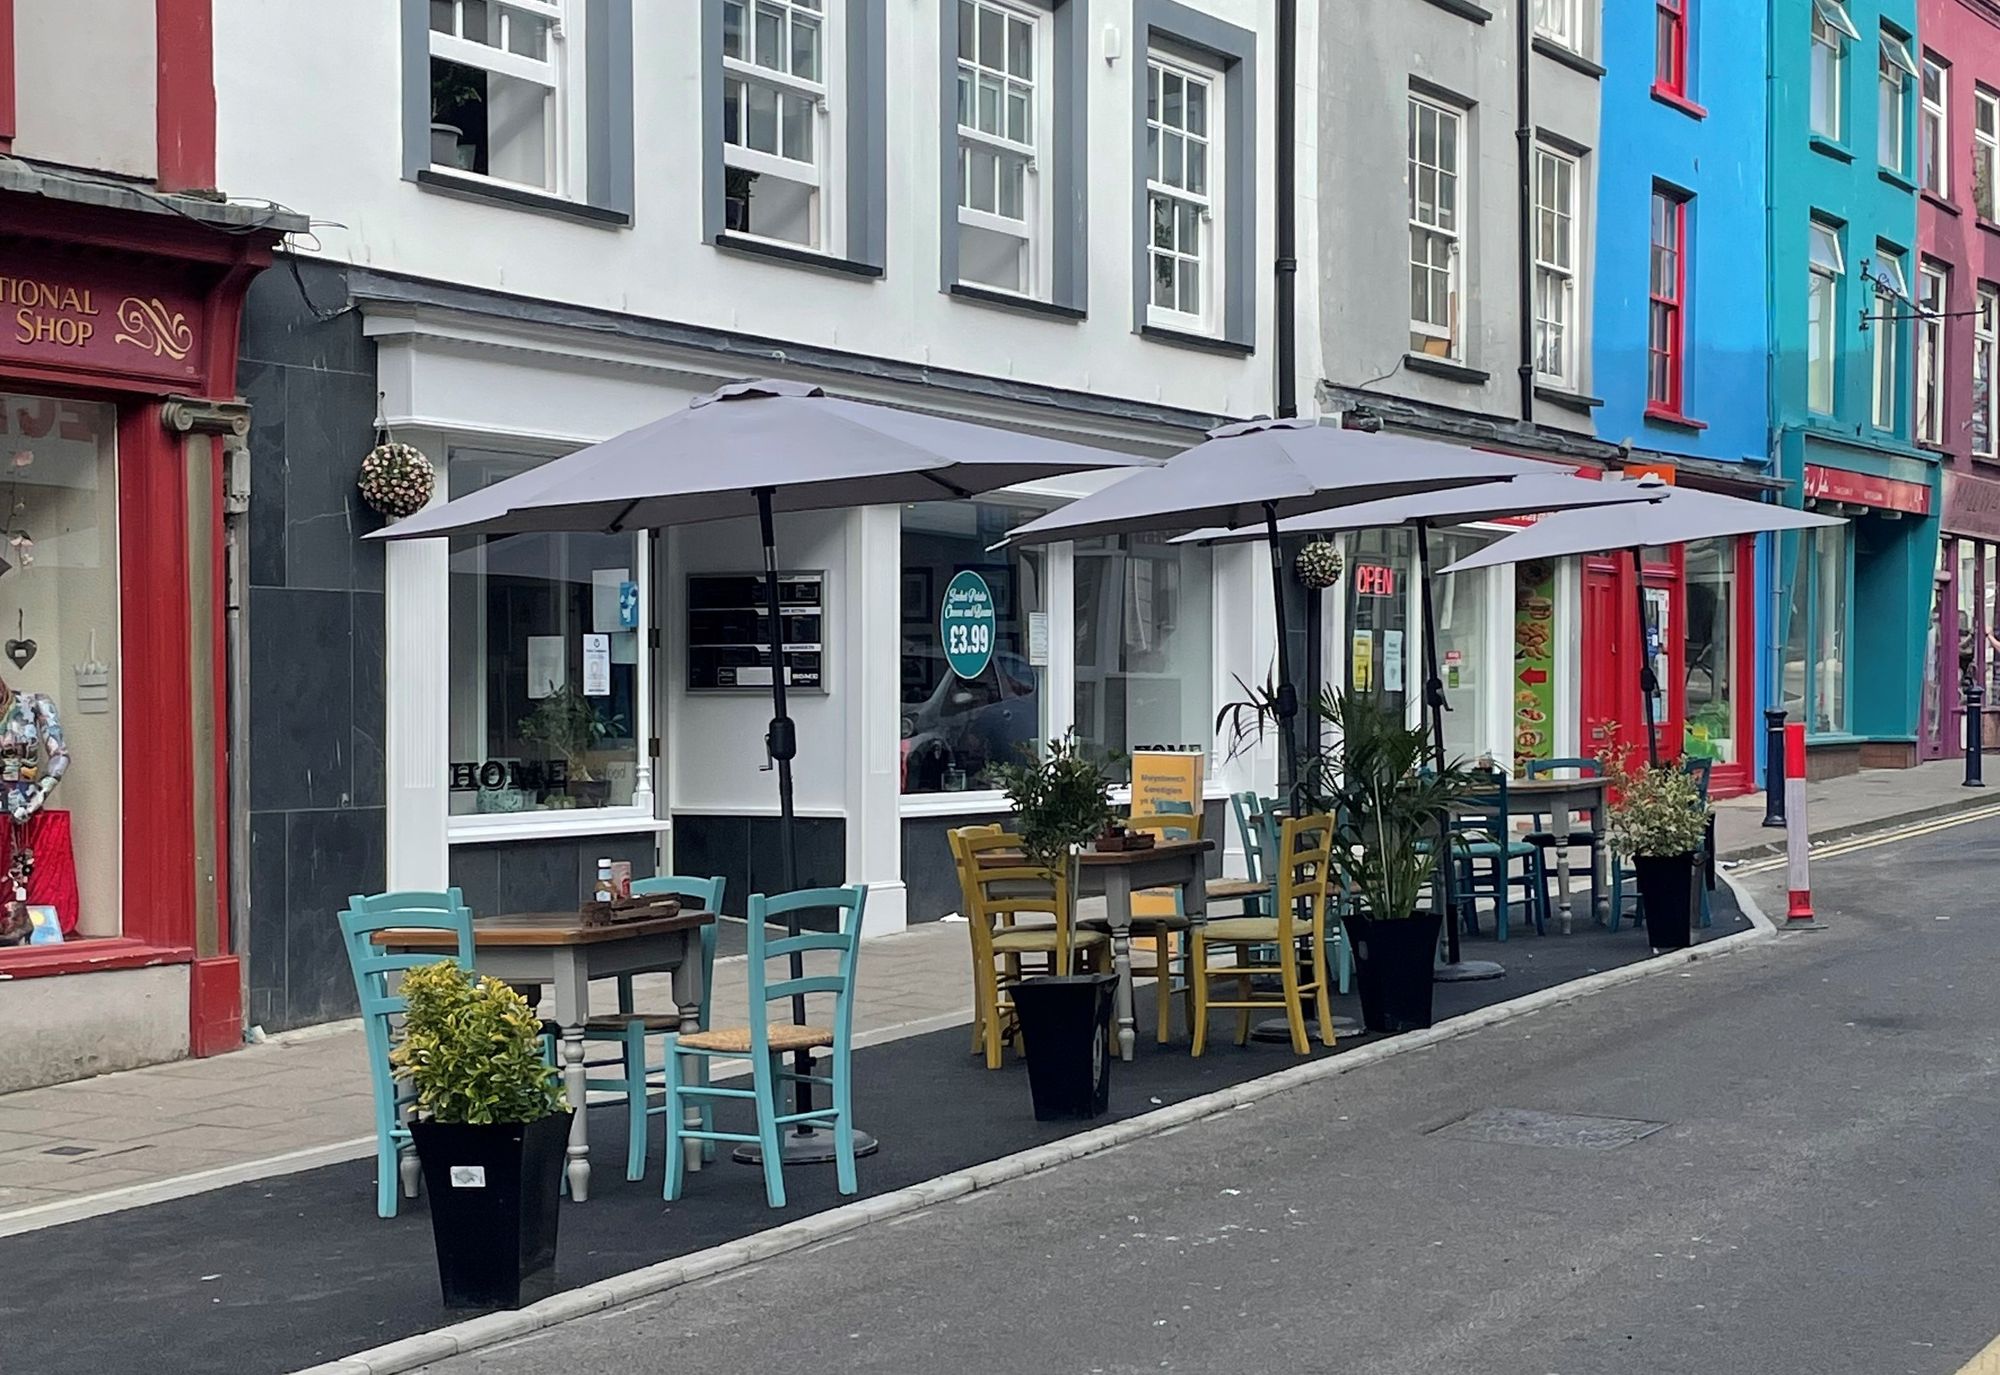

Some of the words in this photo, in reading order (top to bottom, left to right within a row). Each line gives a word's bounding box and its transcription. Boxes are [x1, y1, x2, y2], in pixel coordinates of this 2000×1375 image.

[0, 276, 99, 315] TIONAL
[1357, 565, 1393, 595] OPEN
[949, 625, 989, 655] £3.99
[449, 760, 569, 791] HOME
